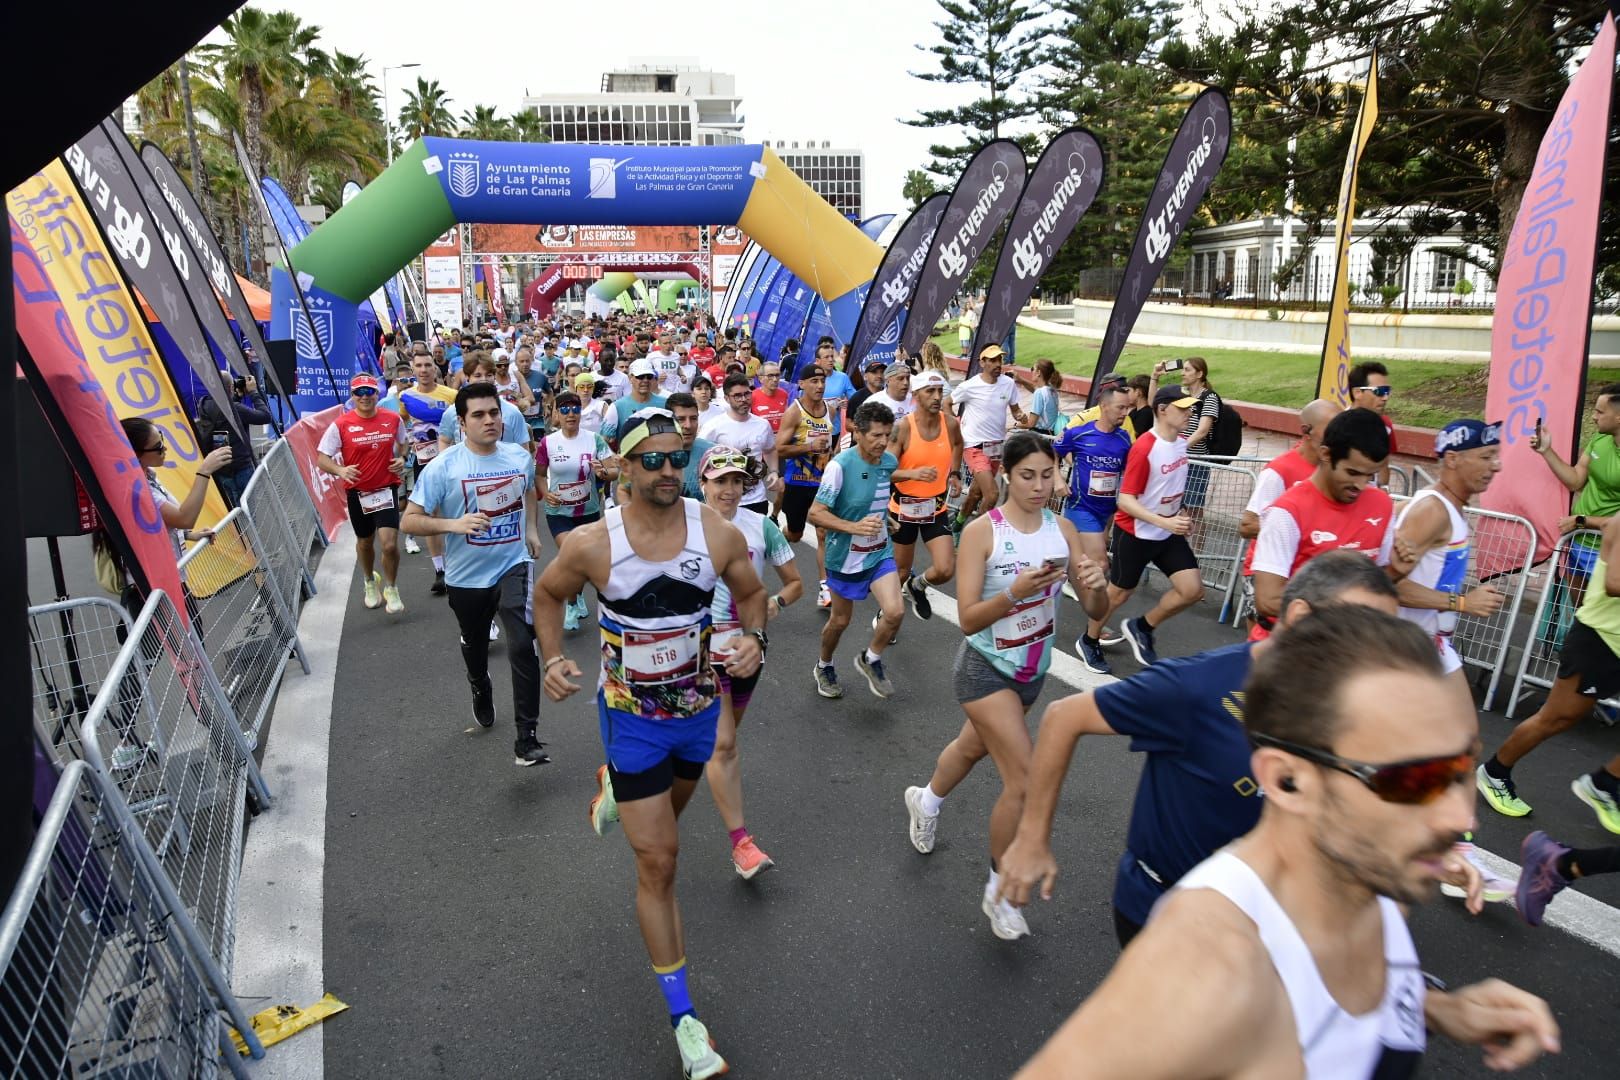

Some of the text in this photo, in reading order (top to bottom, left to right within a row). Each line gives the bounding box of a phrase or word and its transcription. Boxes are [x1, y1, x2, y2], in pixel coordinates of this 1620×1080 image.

[486, 163, 570, 174] Ayuntamiento
[486, 174, 571, 185] de Las Palmas
[1165, 135, 1211, 223] EVENTOS
[486, 185, 571, 197] de Gran Canaria
[635, 182, 647, 190] Las
[649, 182, 674, 190] Palmas
[675, 182, 685, 190] de
[706, 183, 734, 191] Canaria
[958, 175, 1005, 247] EVENTOS
[1032, 168, 1082, 244] EVENTOS
[580, 230, 636, 241] LAS EMPRESAS
[902, 228, 937, 280] EVENT
[661, 361, 676, 369] HD
[484, 469, 520, 478] CANARIAS
[496, 494, 508, 504] 276
[1016, 616, 1037, 633] 1603
[651, 649, 677, 666] 1518
